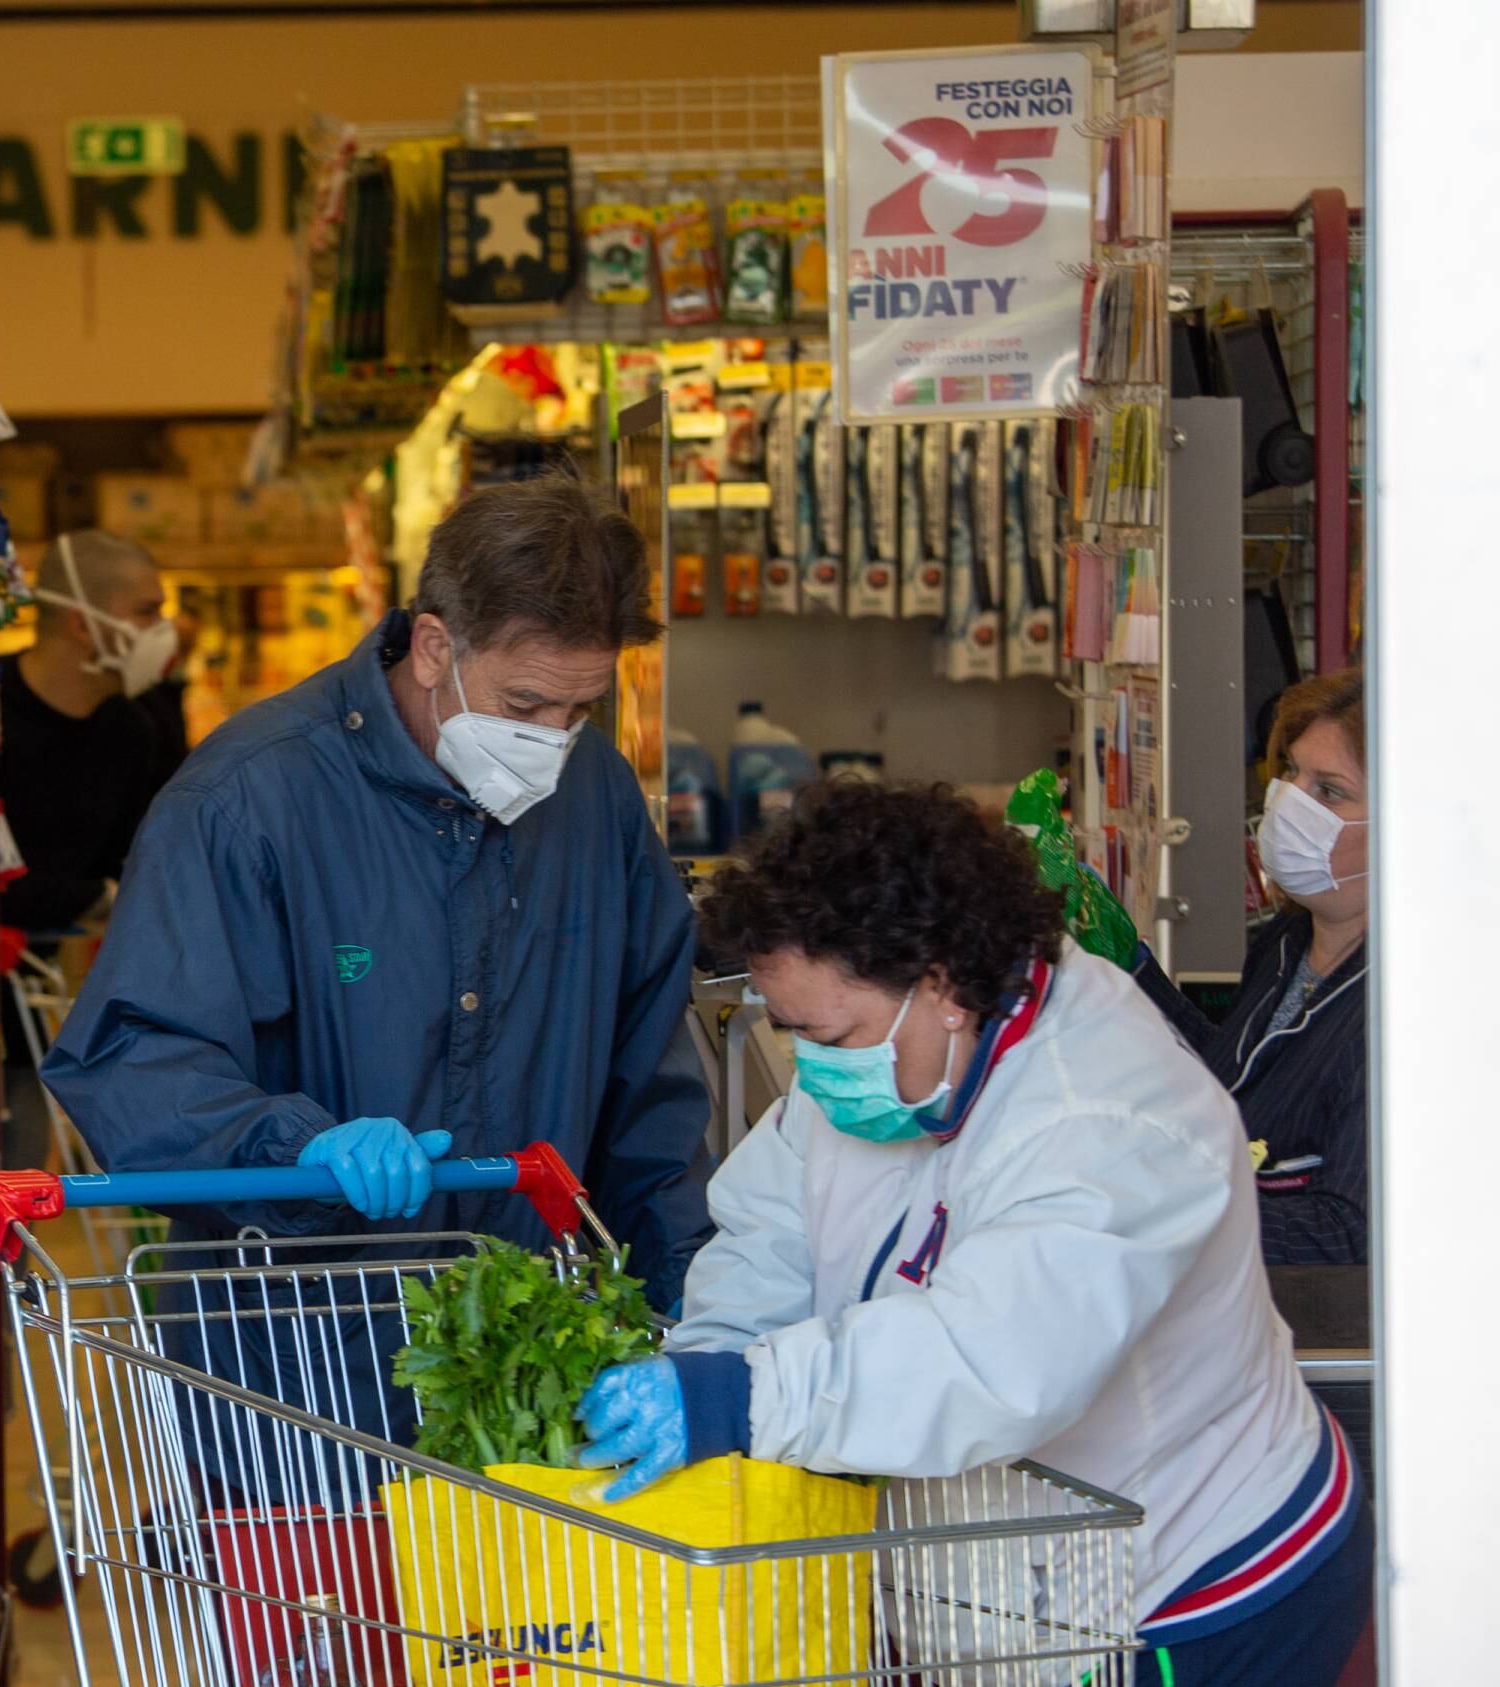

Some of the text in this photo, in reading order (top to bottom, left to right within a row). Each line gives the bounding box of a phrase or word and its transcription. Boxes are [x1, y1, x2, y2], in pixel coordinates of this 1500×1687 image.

[936, 77, 1073, 101] FESTEGGIA
[966, 97, 1073, 120] CON NOI
[862, 117, 1059, 247] 25
[848, 245, 945, 279] ANNI
[1014, 350, 1029, 361] te
